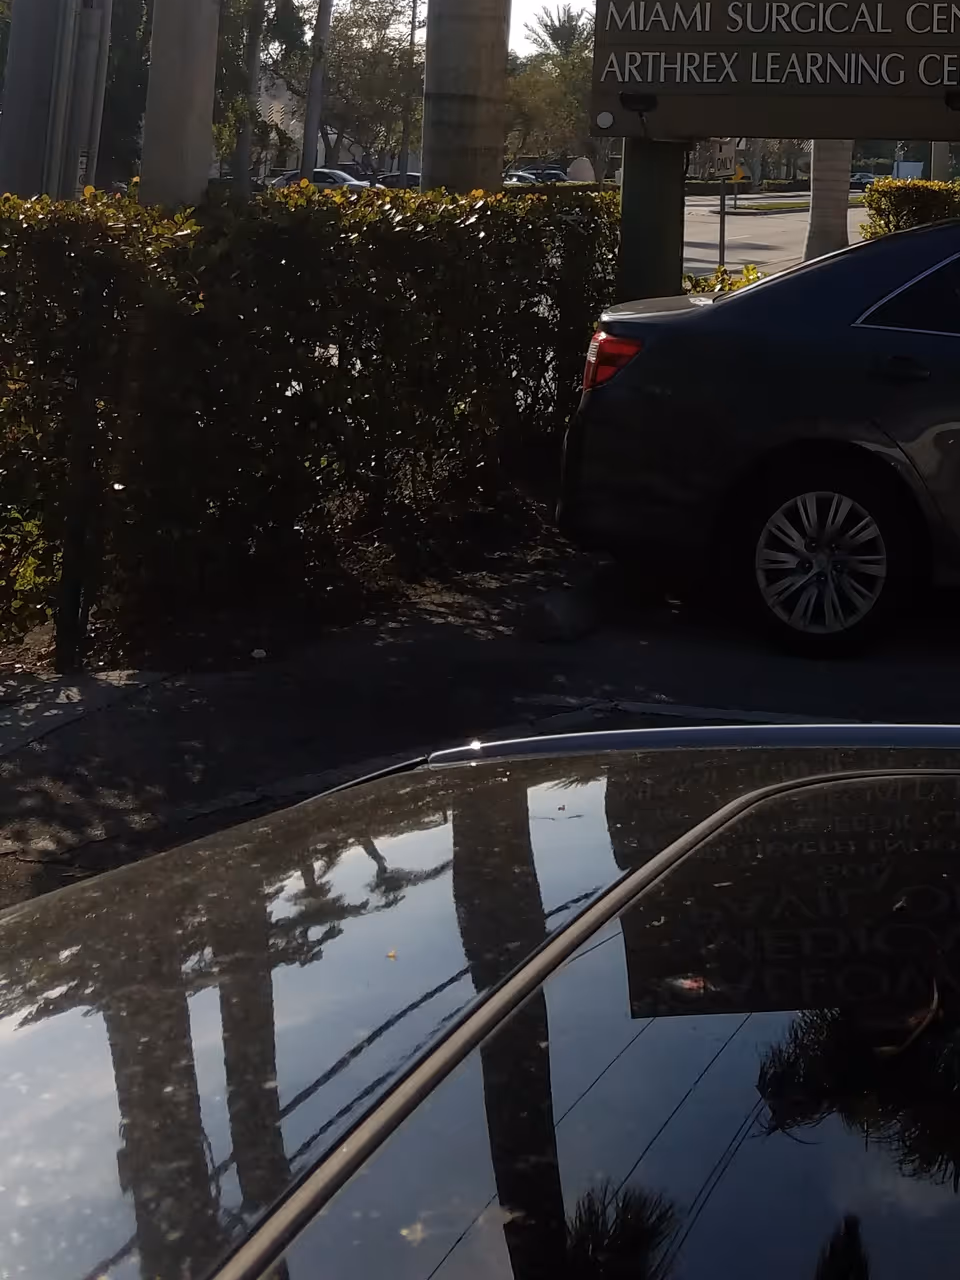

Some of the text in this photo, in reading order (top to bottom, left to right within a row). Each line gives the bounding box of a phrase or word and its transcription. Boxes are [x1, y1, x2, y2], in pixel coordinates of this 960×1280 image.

[605, 1, 711, 32] MIAMI
[726, 1, 892, 34] SURGICAL
[600, 51, 738, 83] ARTHREX
[751, 51, 905, 86] LEARNING
